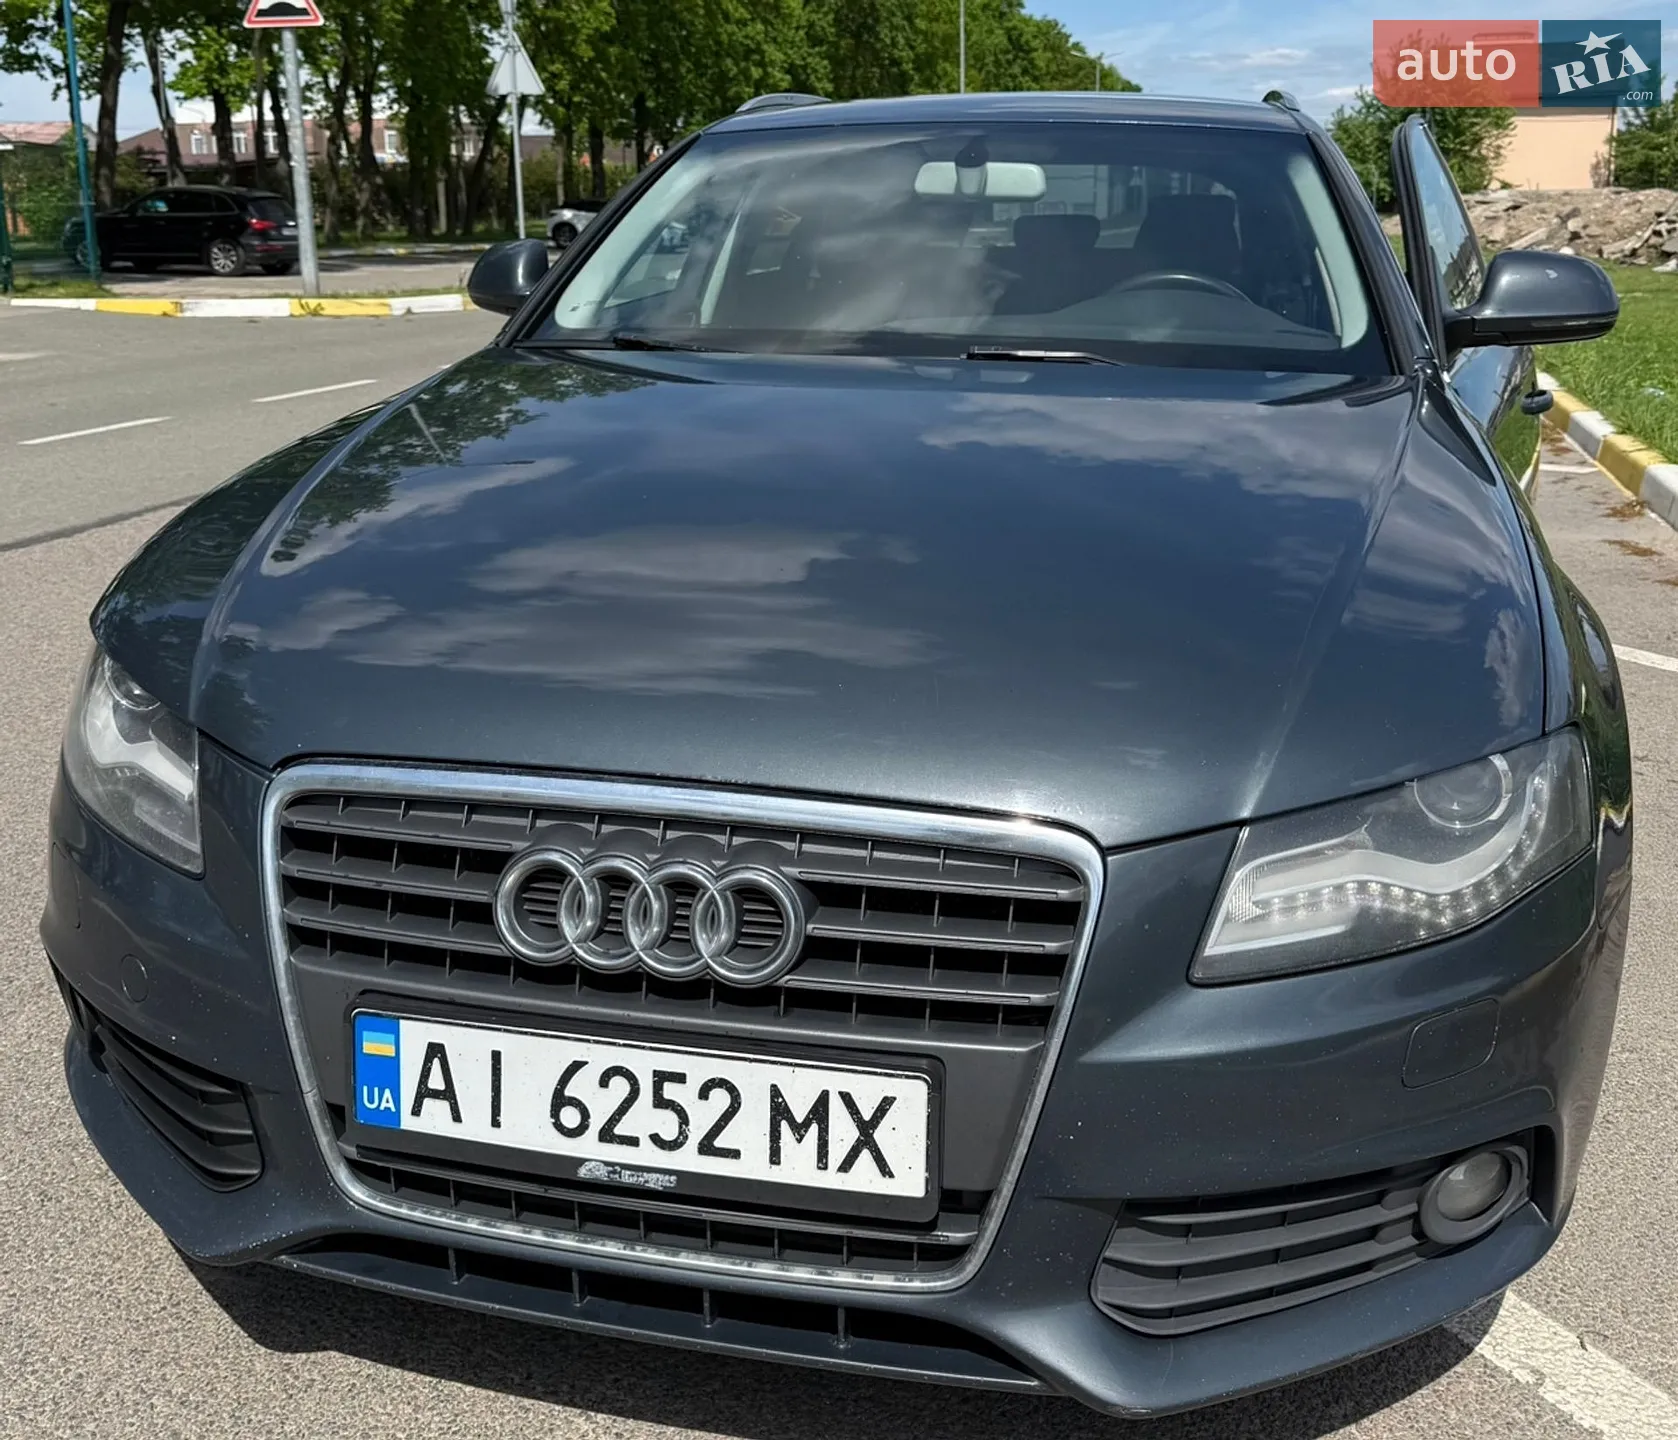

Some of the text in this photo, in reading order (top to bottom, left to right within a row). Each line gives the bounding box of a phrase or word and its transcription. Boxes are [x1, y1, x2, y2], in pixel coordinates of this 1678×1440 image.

[362, 1085, 396, 1112] UA
[410, 1041, 897, 1179] AI 6252 MX
